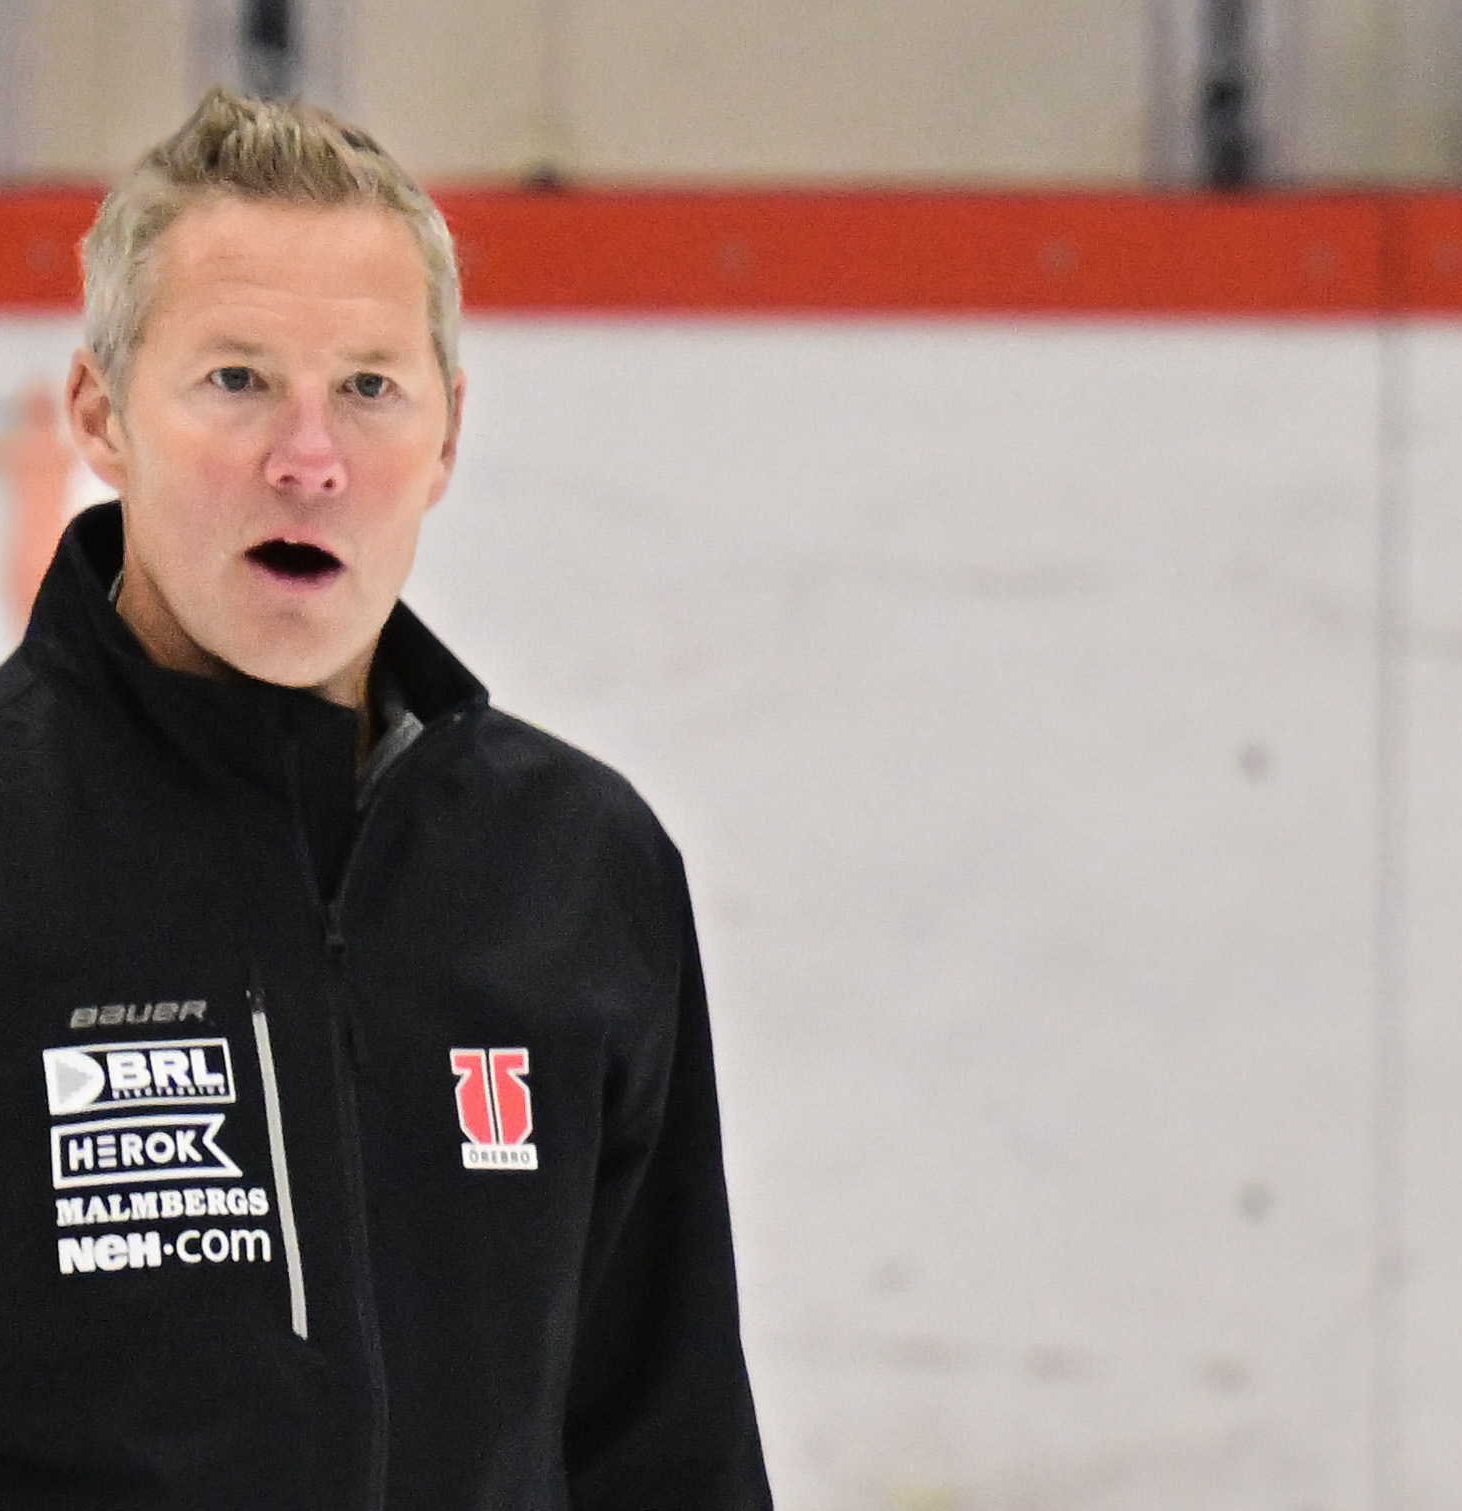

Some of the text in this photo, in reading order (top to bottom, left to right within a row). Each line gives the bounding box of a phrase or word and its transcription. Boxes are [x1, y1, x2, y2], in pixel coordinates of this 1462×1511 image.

[70, 1000, 207, 1029] BAUER
[106, 1048, 225, 1090] BRL
[68, 1128, 203, 1172] HEROK
[55, 1187, 270, 1228] MALMBERGS
